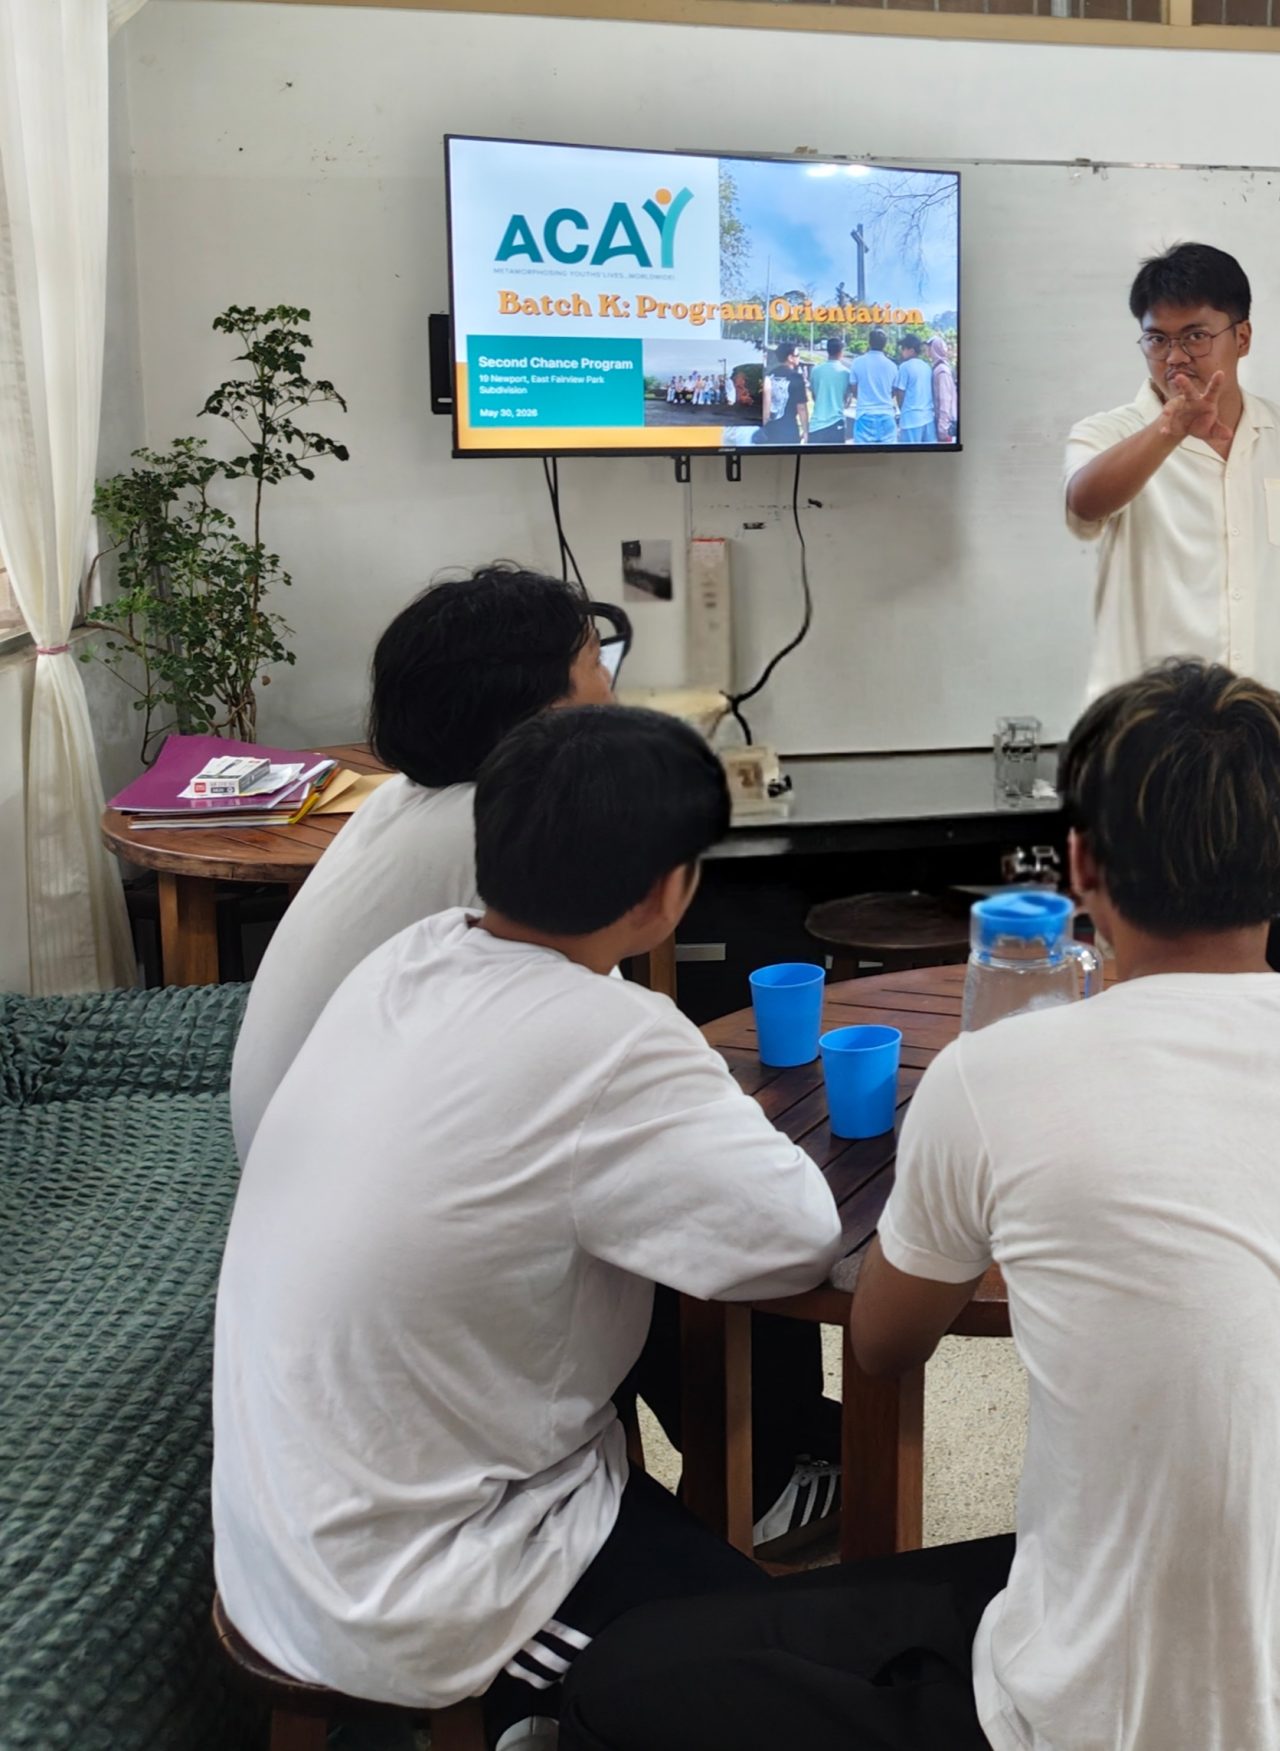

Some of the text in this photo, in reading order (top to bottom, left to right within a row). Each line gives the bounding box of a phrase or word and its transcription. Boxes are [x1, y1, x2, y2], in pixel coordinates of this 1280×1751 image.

[494, 187, 695, 268] ACAY
[498, 290, 923, 326] Batch K: Program Orientation
[478, 356, 633, 371] Second Chance Program
[491, 375, 529, 384] Newport,
[531, 375, 549, 383] East
[551, 375, 584, 383] Fairview
[479, 386, 528, 394] Subdivision
[480, 408, 498, 418] May
